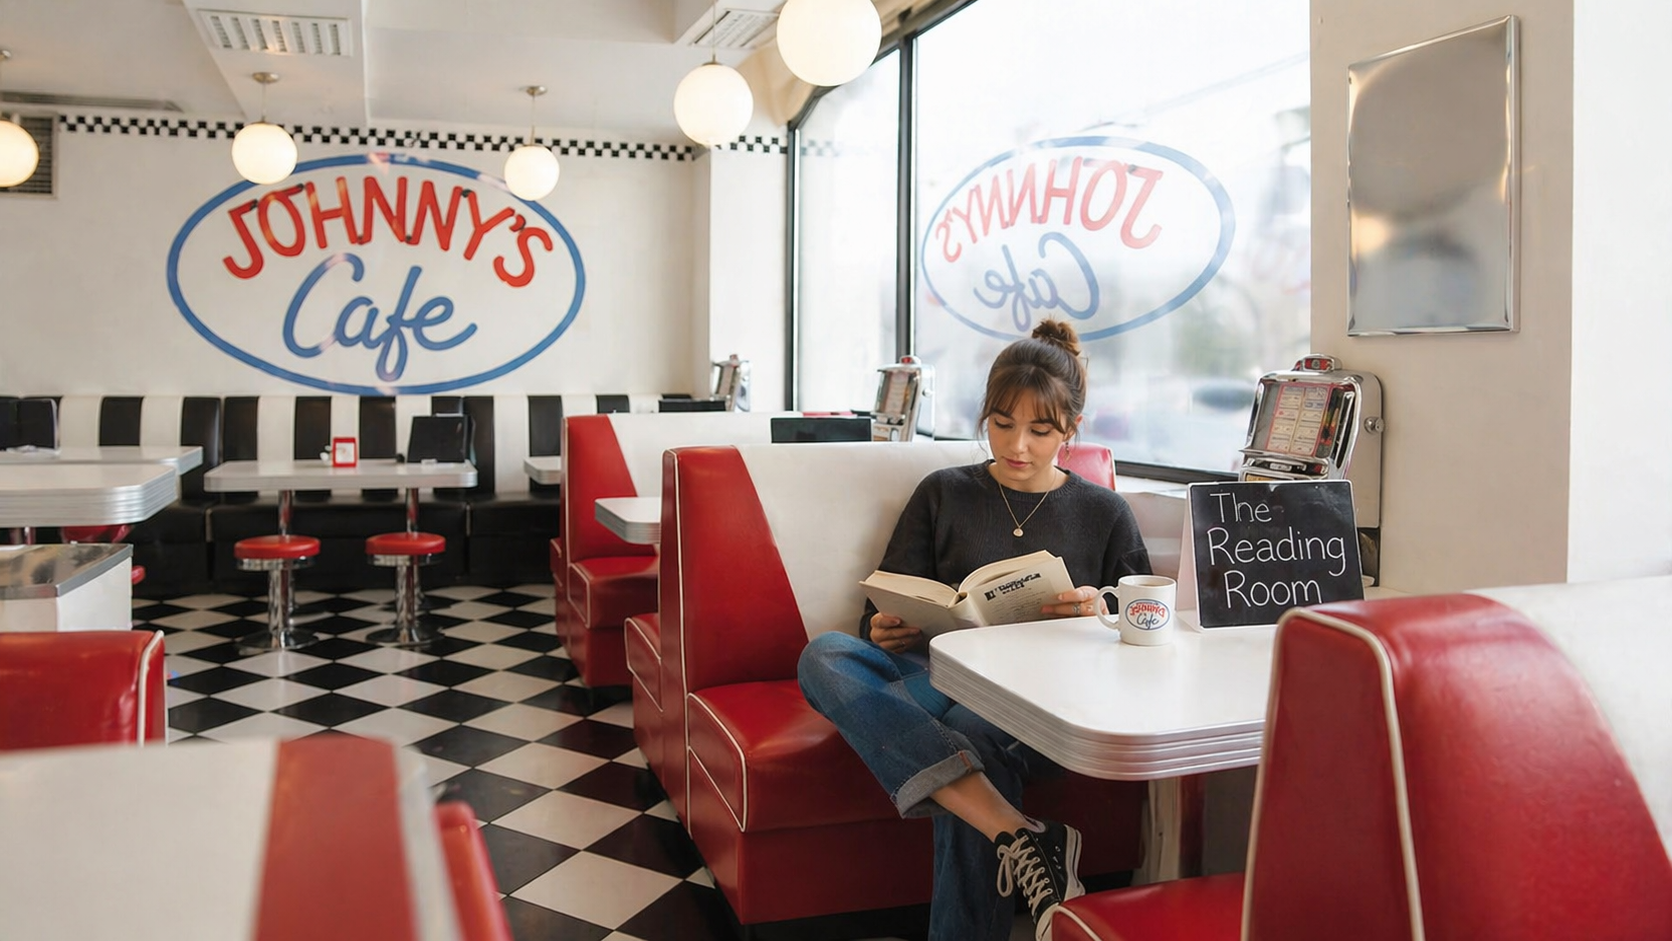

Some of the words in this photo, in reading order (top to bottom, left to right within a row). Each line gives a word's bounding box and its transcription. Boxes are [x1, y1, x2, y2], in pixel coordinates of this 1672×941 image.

[222, 176, 553, 288] JOHNNY'S
[282, 252, 478, 382] Cafe
[1209, 492, 1272, 523] The
[1207, 526, 1346, 577] Reading
[1224, 570, 1323, 609] Room
